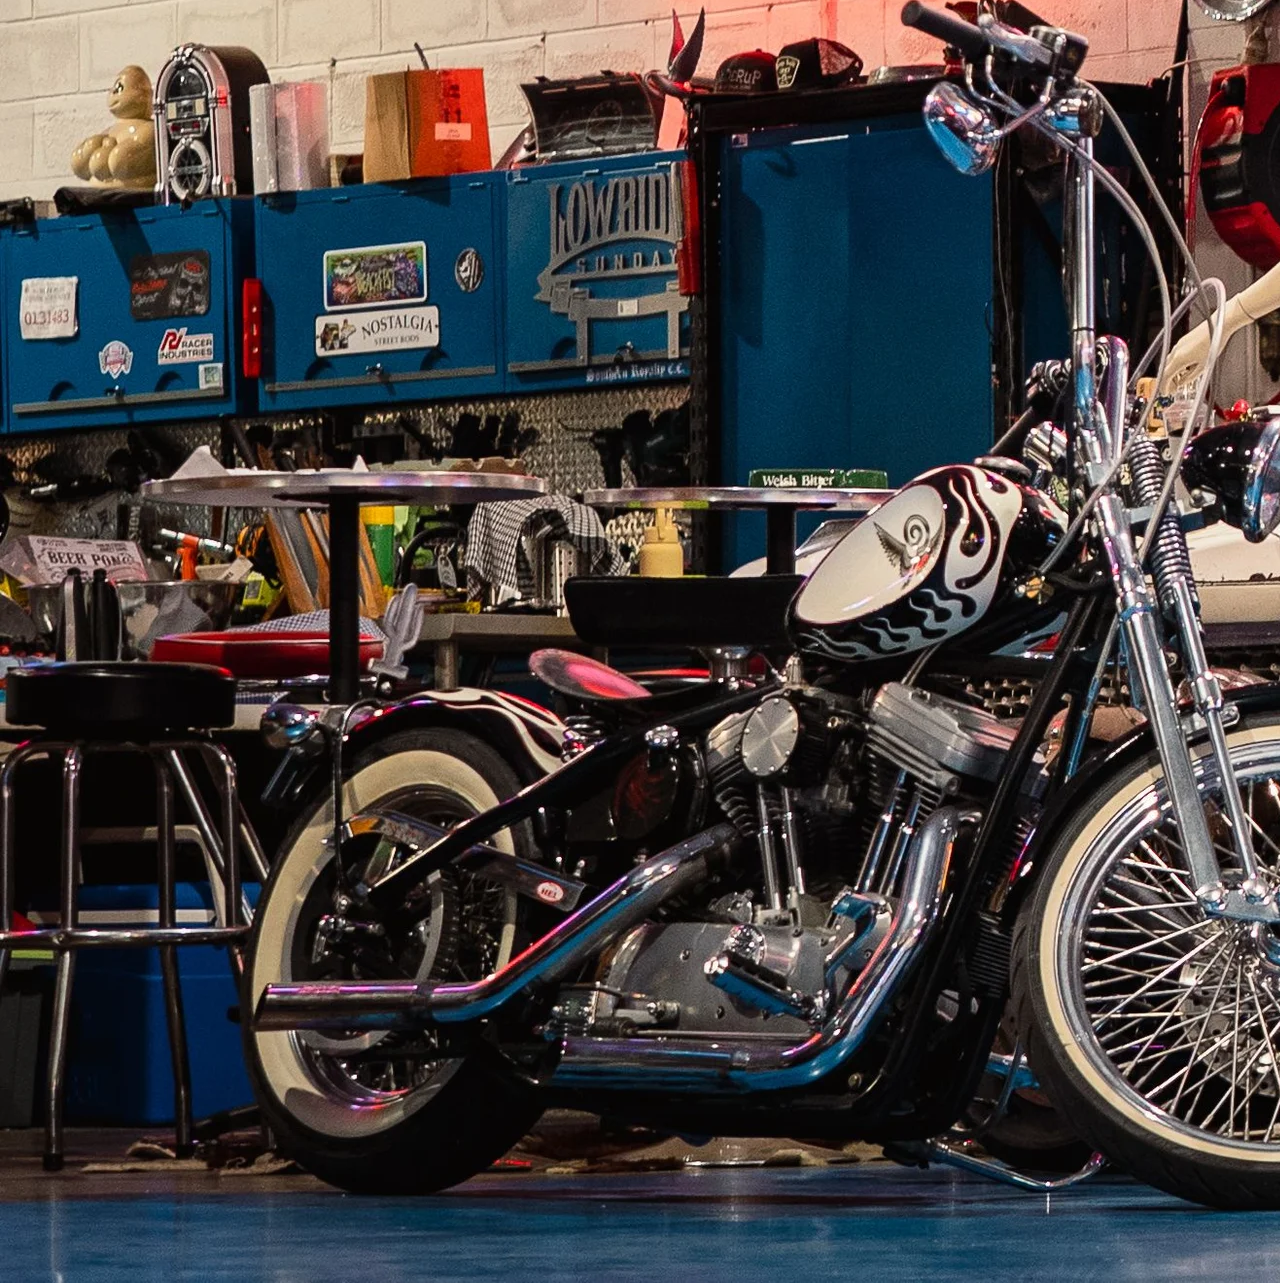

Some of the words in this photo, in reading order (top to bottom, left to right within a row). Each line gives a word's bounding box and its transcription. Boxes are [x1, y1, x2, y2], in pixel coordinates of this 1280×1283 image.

[361, 314, 434, 341] NOSTALGIA
[181, 339, 213, 349] RACER
[374, 336, 399, 346] STREET
[159, 347, 213, 360] INDUSTRIES
[762, 474, 797, 488] Welsh
[801, 475, 836, 488] Bitter
[47, 550, 88, 566] BEER
